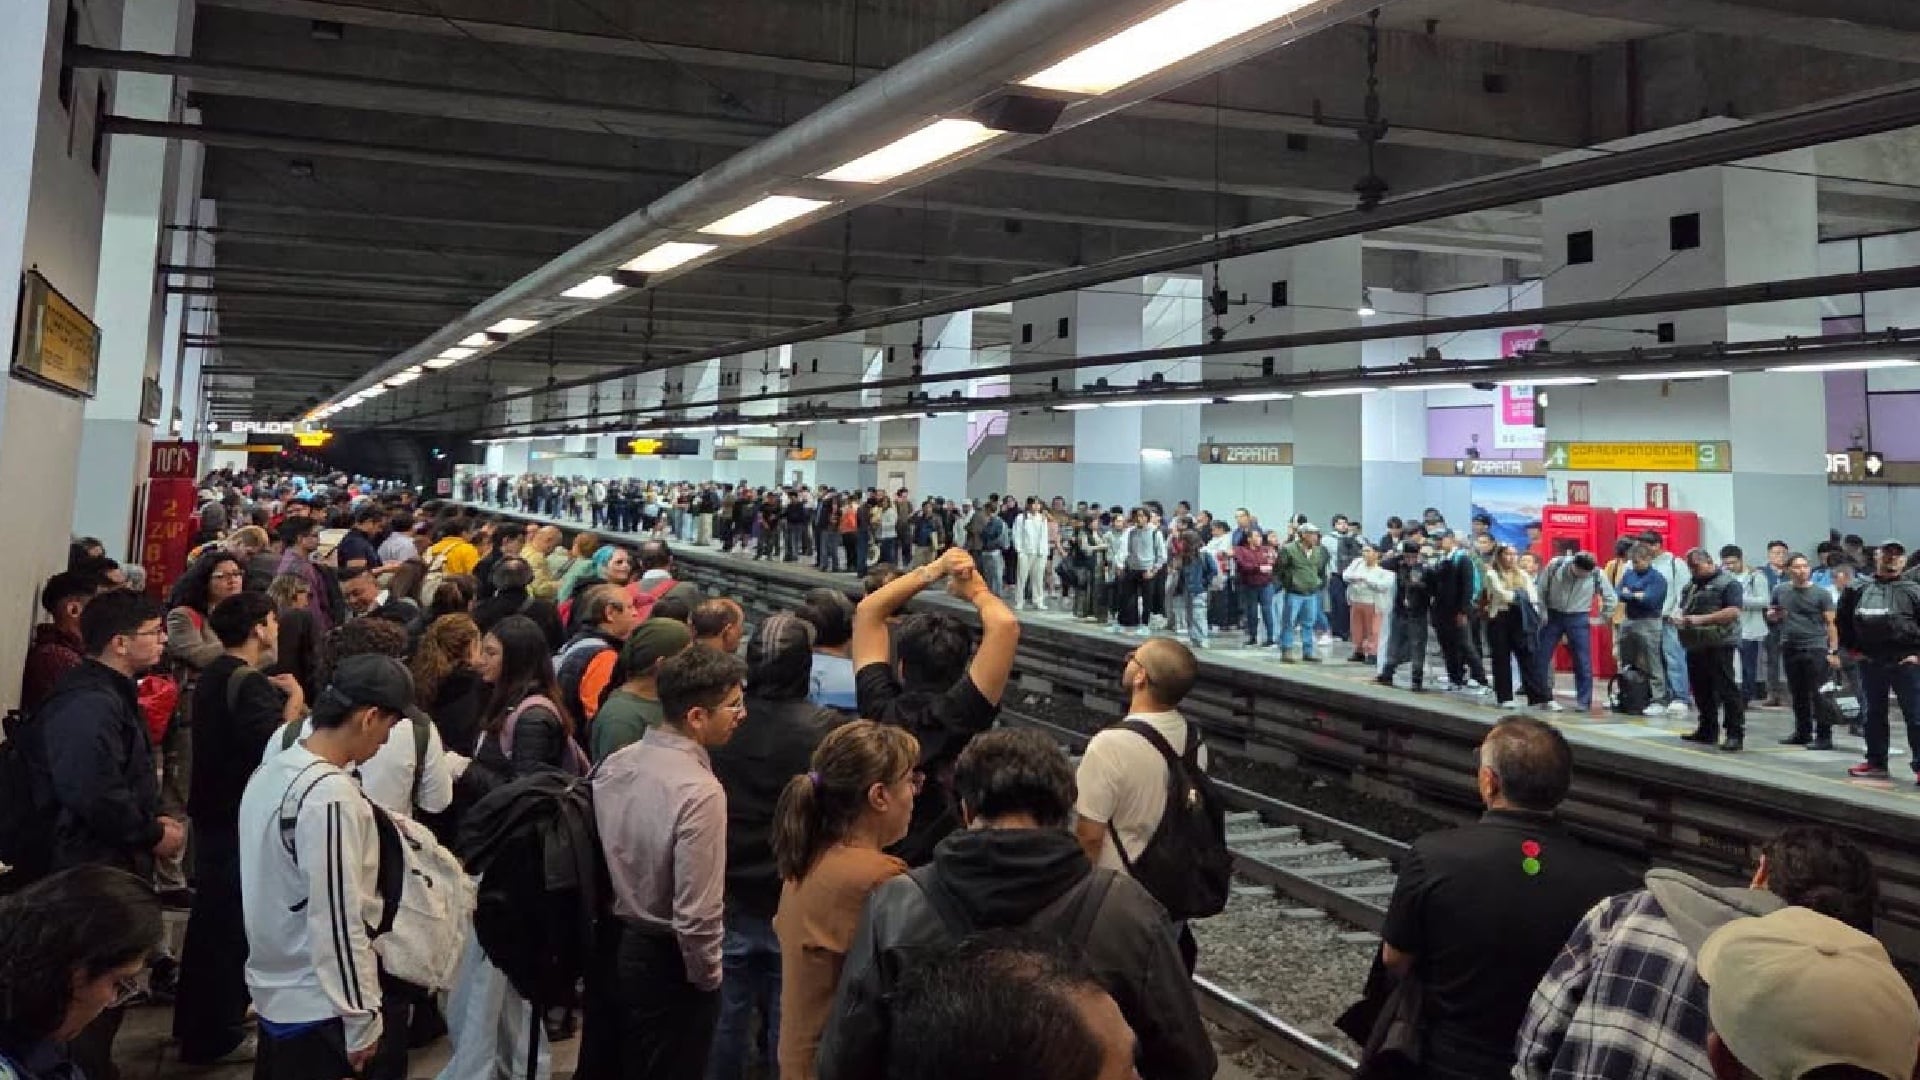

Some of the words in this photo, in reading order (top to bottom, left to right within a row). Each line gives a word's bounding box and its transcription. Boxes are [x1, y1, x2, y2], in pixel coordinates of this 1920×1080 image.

[1226, 447, 1279, 461] ZAPATA
[1571, 444, 1693, 456] CORRESPONDENCIA
[1700, 445, 1715, 462] 3
[1471, 460, 1522, 474] ZAPATA
